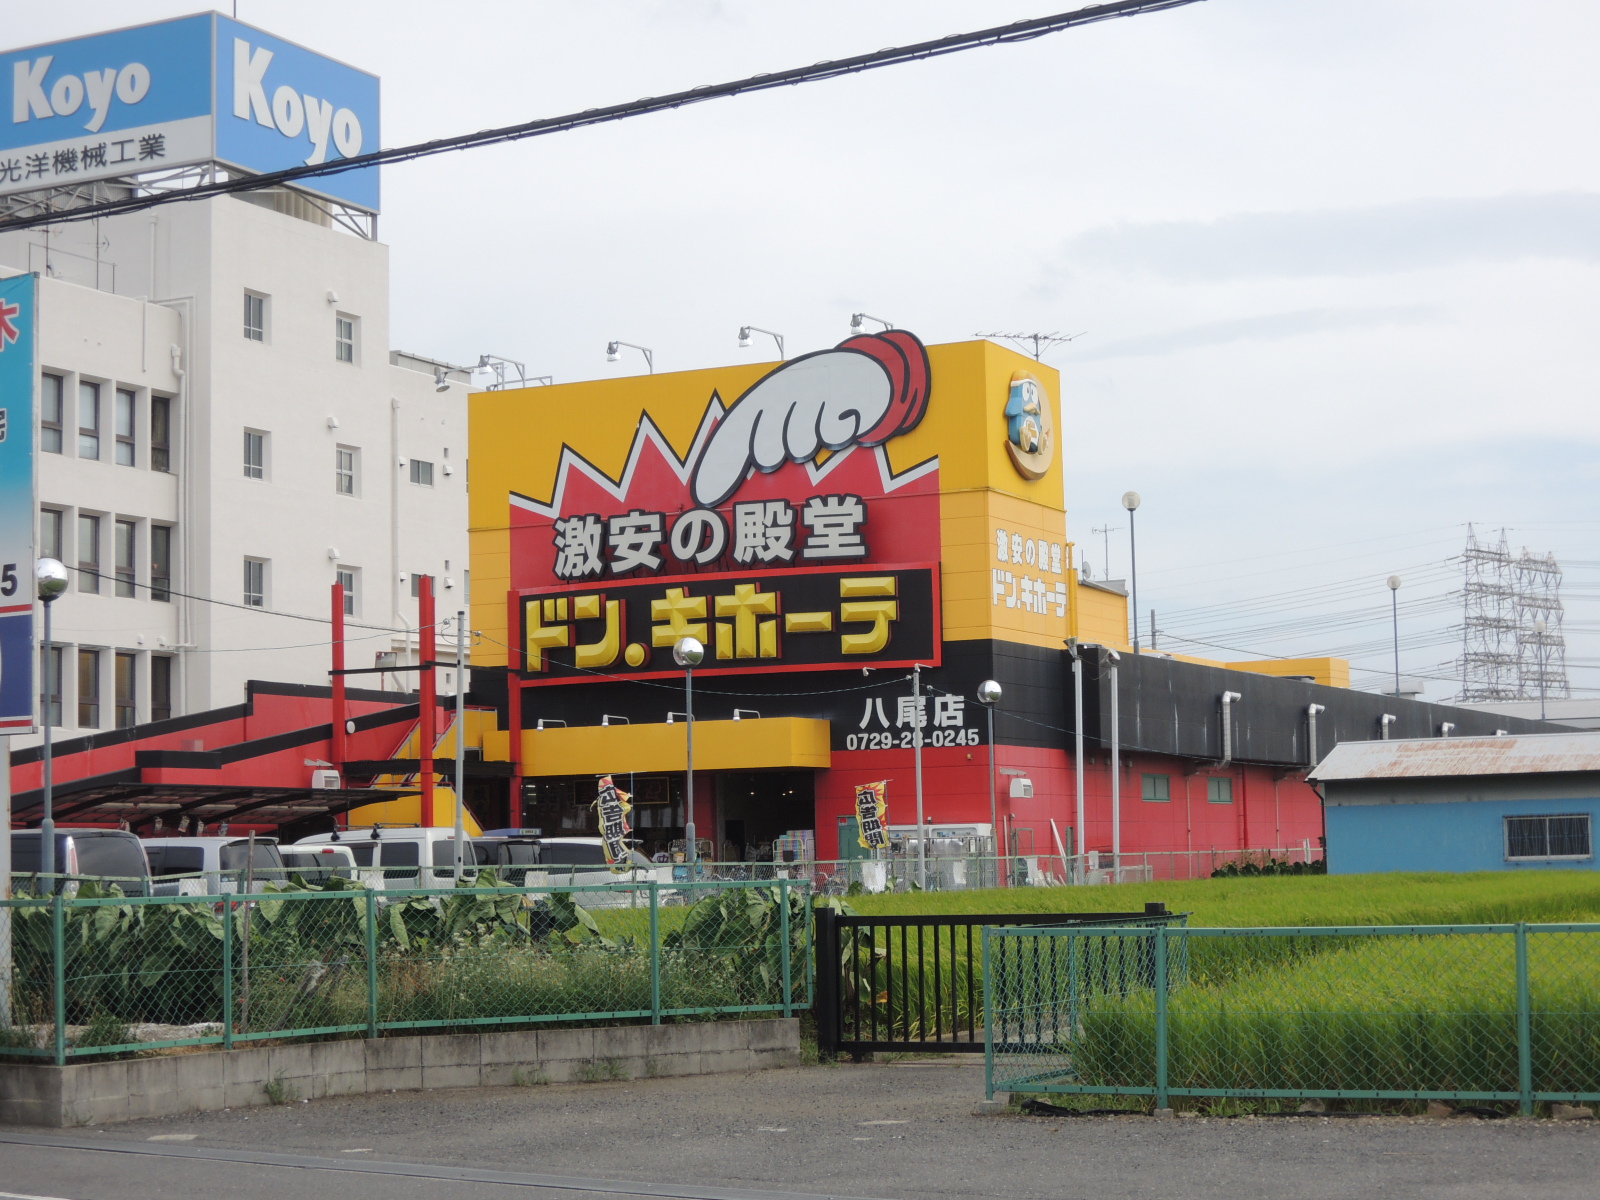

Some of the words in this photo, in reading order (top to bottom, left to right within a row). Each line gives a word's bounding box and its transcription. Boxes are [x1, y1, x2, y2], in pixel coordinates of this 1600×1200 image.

[13, 55, 150, 133] Koyo
[233, 37, 363, 167] Koyo
[0, 132, 166, 183] 光洋機械工業
[553, 495, 868, 579] 激安の殿堂
[859, 693, 965, 729] 八尾店
